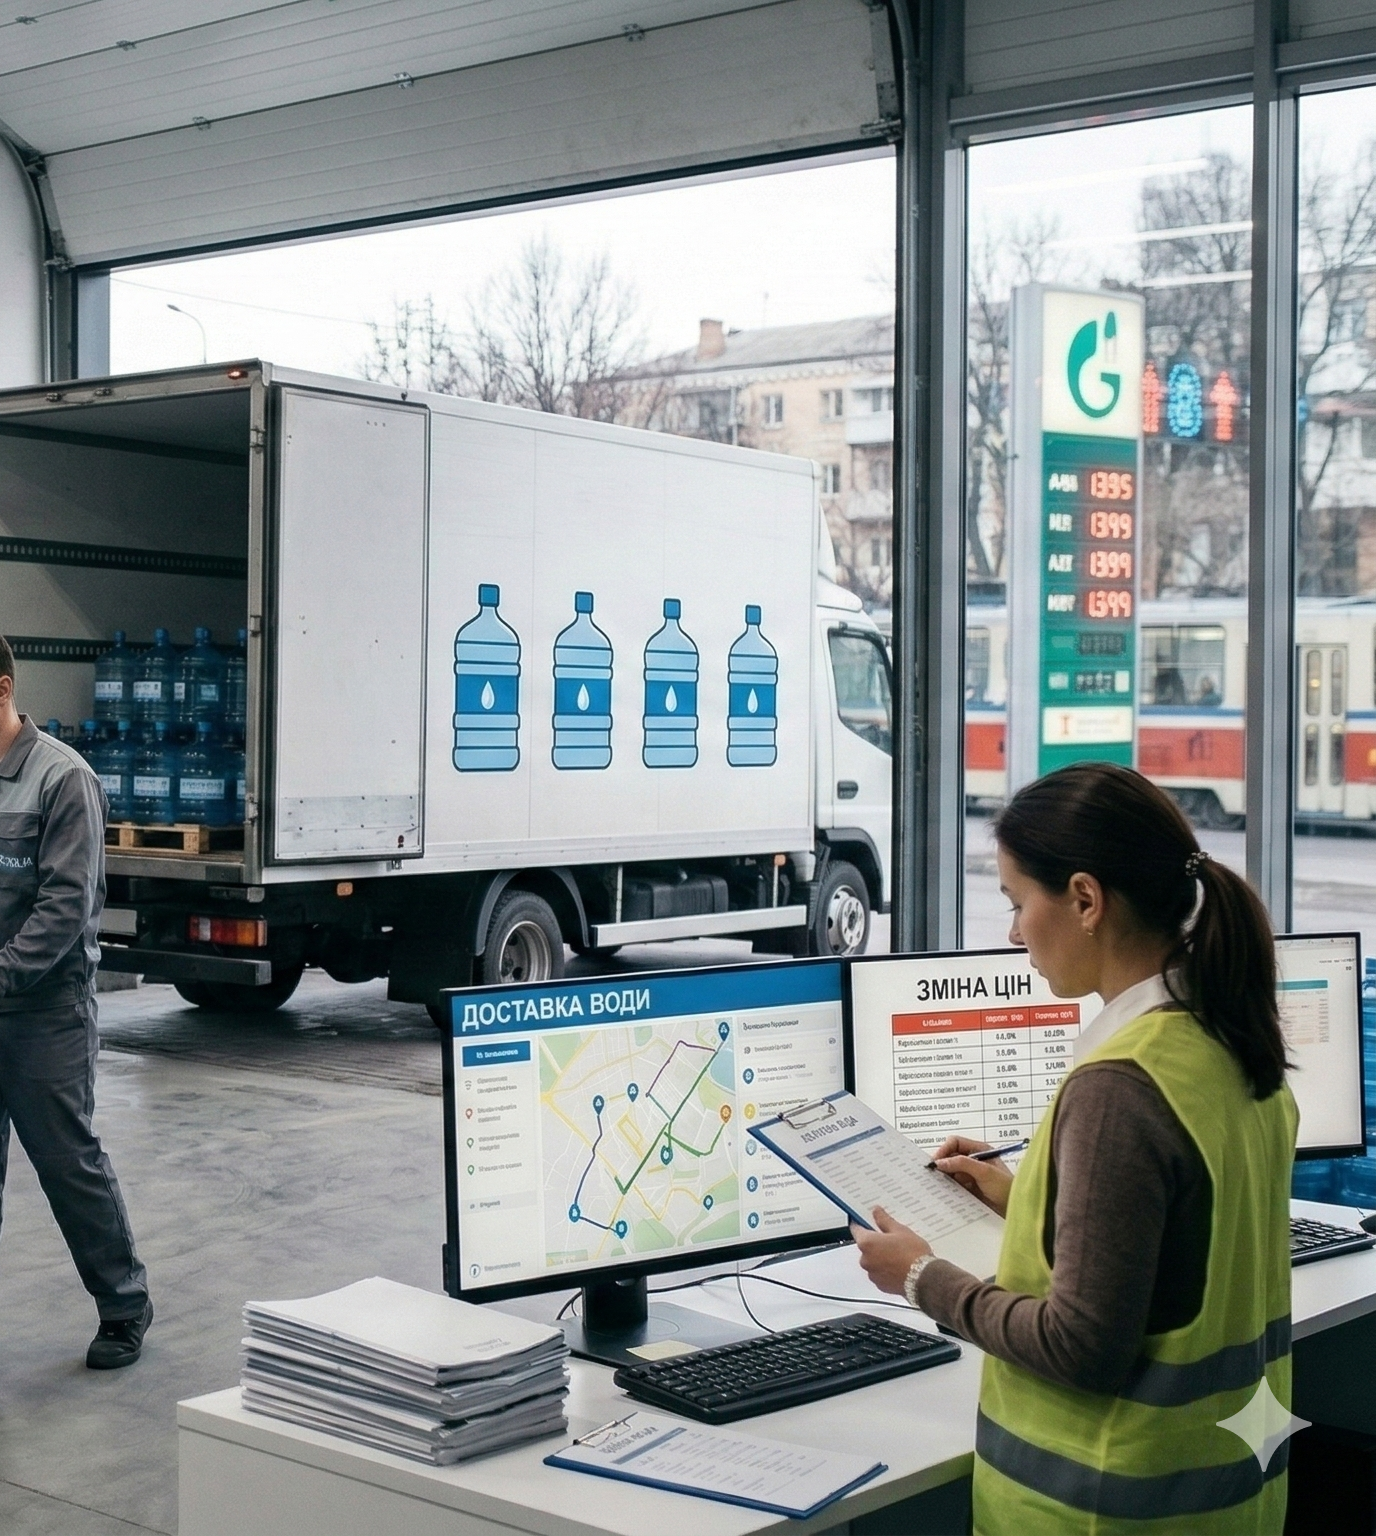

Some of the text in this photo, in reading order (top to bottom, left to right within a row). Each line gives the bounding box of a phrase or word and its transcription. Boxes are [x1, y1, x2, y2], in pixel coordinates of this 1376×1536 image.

[917, 974, 1031, 1001] ЗМІНА ЦІН
[462, 989, 650, 1031] ДОСТАВКА ВОДИ
